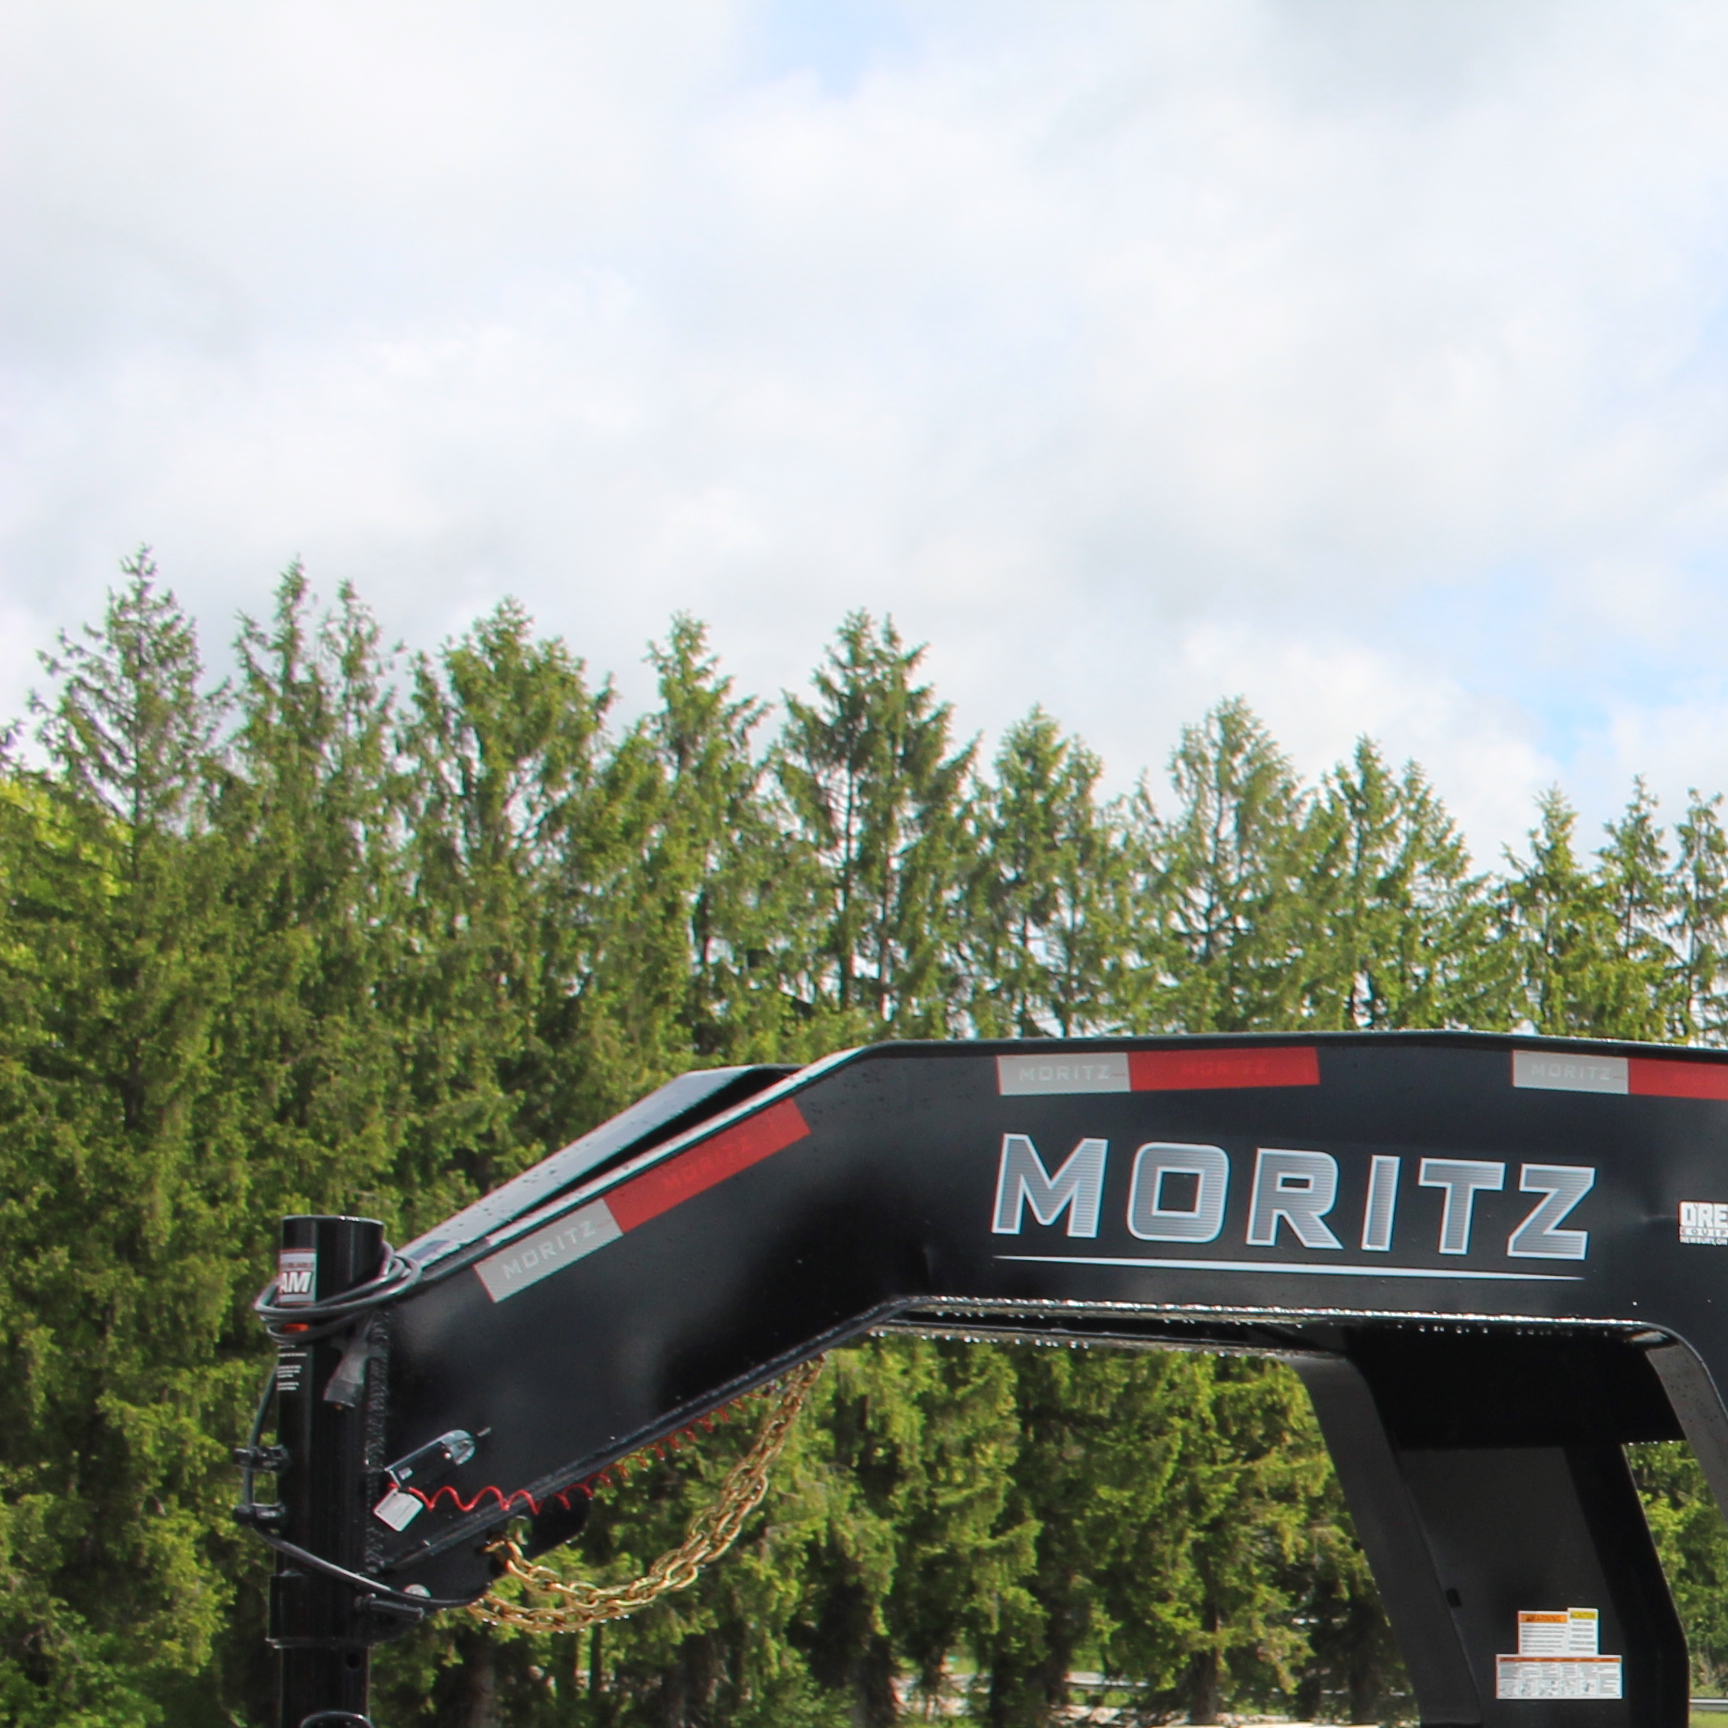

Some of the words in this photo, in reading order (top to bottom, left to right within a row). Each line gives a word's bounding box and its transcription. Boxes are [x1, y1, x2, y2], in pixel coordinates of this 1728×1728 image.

[1019, 1064, 1110, 1083] MORITZ
[1531, 1062, 1611, 1082] MORITZ
[992, 1132, 1596, 1261] MORITZ
[502, 1220, 597, 1280] MORITZ
[278, 1271, 313, 1294] AM
